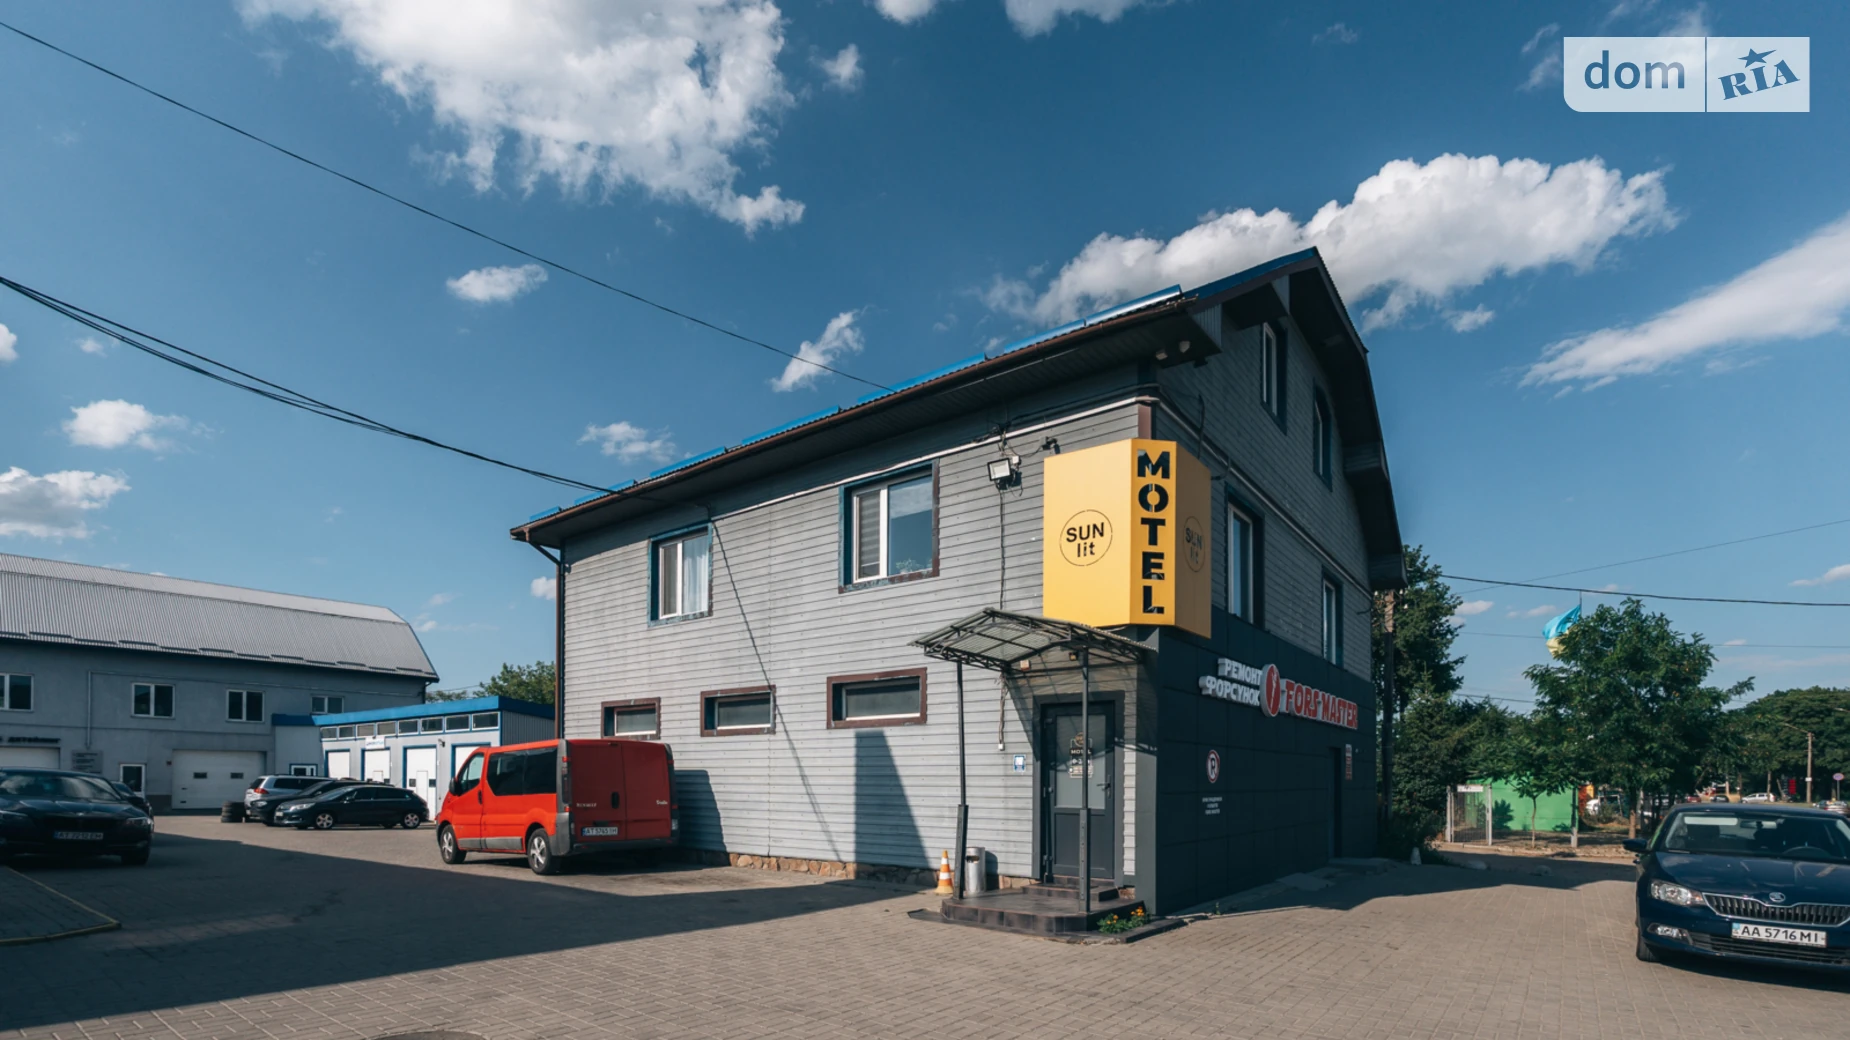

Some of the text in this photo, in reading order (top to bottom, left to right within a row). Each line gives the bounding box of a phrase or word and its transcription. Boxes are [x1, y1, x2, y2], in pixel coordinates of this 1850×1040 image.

[1066, 522, 1105, 543] SUN
[1137, 448, 1171, 614] MOTEL
[1185, 527, 1203, 550] SUN
[1077, 542, 1096, 557] lit
[1222, 658, 1263, 687] РЕМОНТ
[1205, 675, 1261, 707] ФОРСУНОК
[1286, 680, 1358, 730] FORS MASTER
[1741, 925, 1761, 937] AA
[1765, 928, 1797, 941] 5716
[1800, 931, 1818, 942] MI
